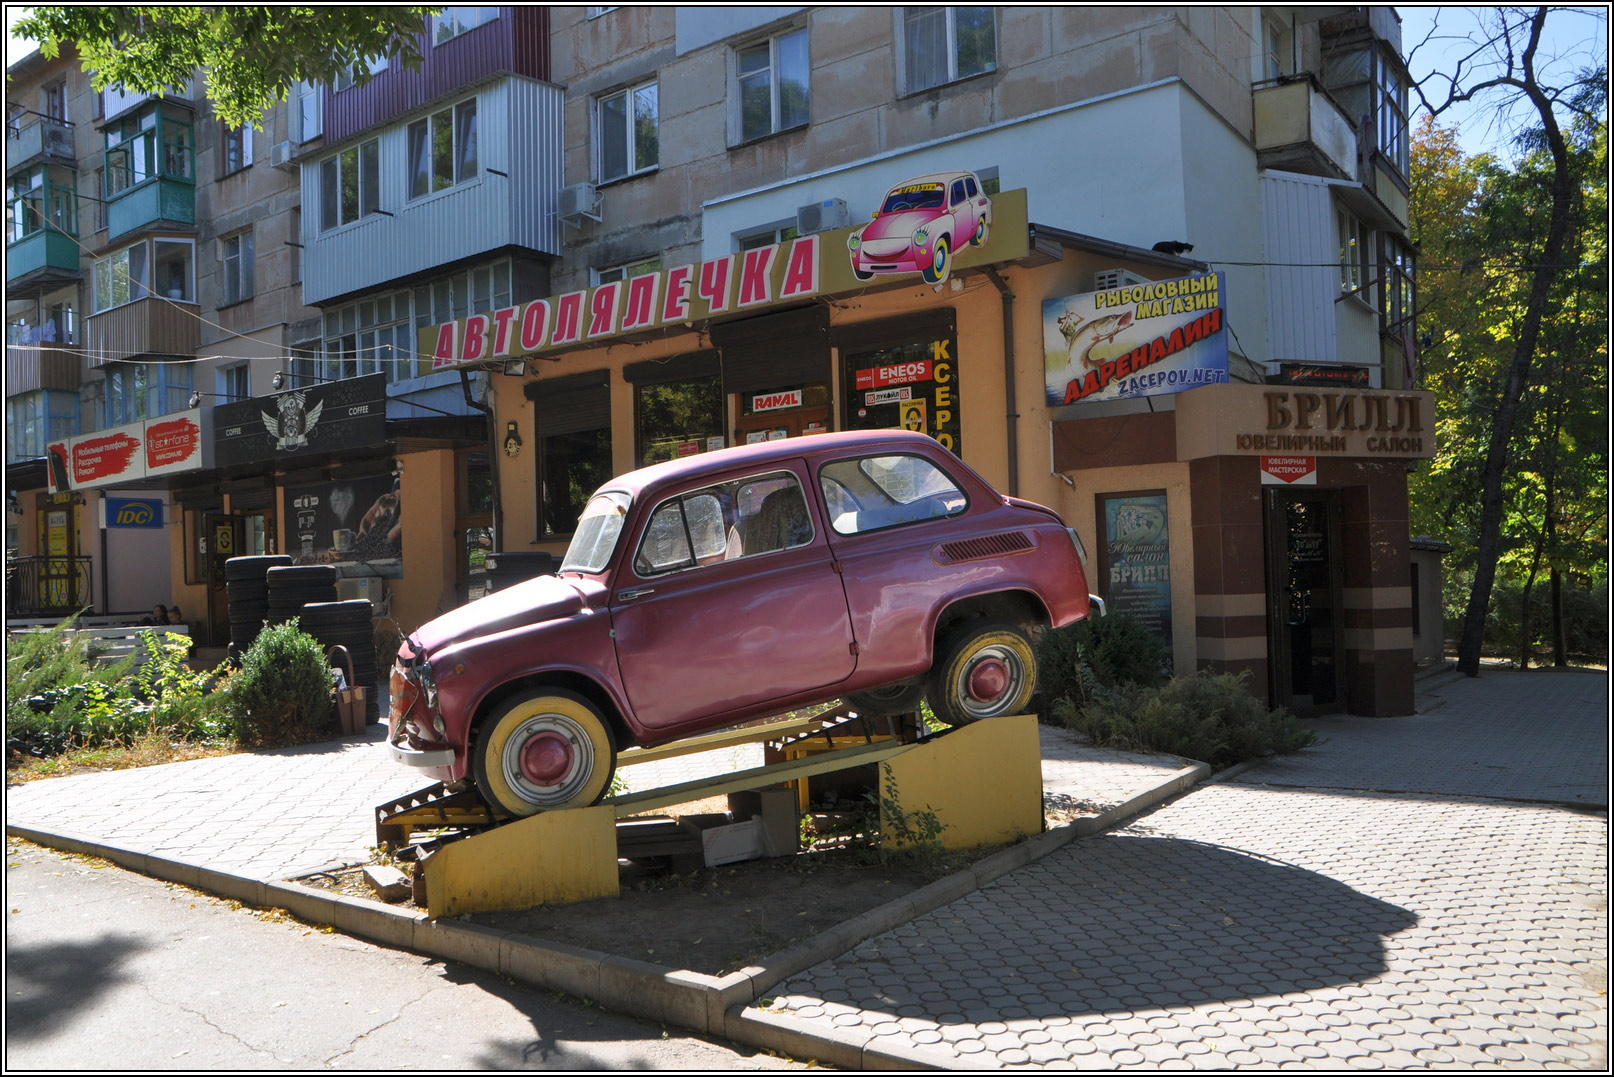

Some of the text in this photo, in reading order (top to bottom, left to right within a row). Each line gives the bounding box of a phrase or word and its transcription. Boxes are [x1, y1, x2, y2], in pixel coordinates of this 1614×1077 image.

[1095, 272, 1219, 310] РЫБОЛОВНЫЙ
[431, 234, 820, 370] АВТОЛЯЛЕЧКА
[1135, 291, 1220, 320] МАГАЗИН
[1063, 308, 1222, 405] АДРЕНАЛИН
[880, 362, 926, 380] ENEOS
[1118, 368, 1226, 396] ZACEPOV.NET
[348, 405, 369, 416] COFFEE
[1263, 392, 1424, 432] БРИЛЛ
[225, 427, 242, 437] COFFEE
[1366, 437, 1423, 452] САЛОН
[1268, 466, 1307, 474] МАСТЕРСКАЯ
[116, 510, 148, 525] IDC
[1126, 552, 1164, 564] салон
